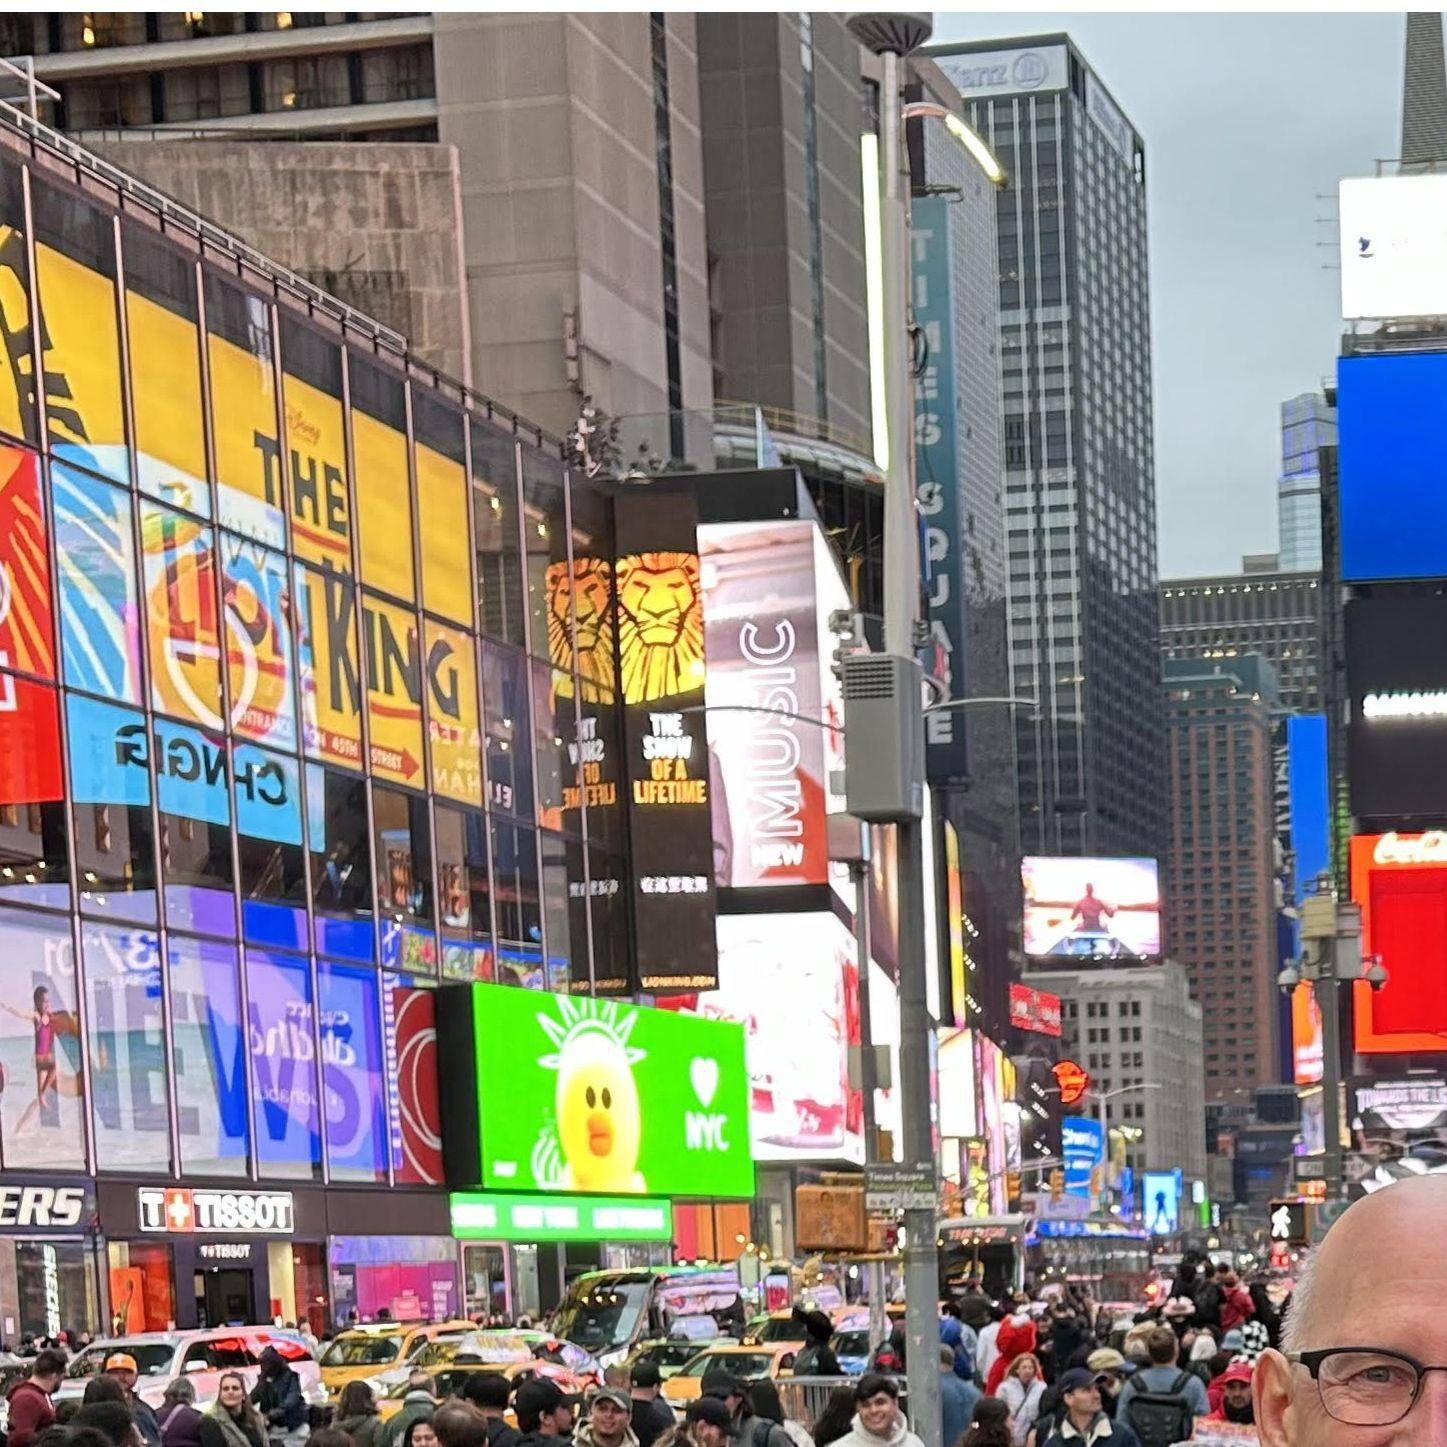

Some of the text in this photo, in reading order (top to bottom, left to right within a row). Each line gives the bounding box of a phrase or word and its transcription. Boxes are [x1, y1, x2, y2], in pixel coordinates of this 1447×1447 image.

[254, 429, 348, 537] THE
[322, 554, 462, 721] KING
[649, 713, 684, 736] THE
[739, 619, 804, 837] MUSIC
[642, 735, 693, 759] SHOW
[651, 759, 688, 781] OF A
[633, 780, 707, 804] LIFETIME
[752, 843, 804, 866] NEW
[684, 1110, 731, 1152] NYC
[194, 1194, 291, 1229] TISSOT
[216, 1244, 251, 1259] TISSOT
